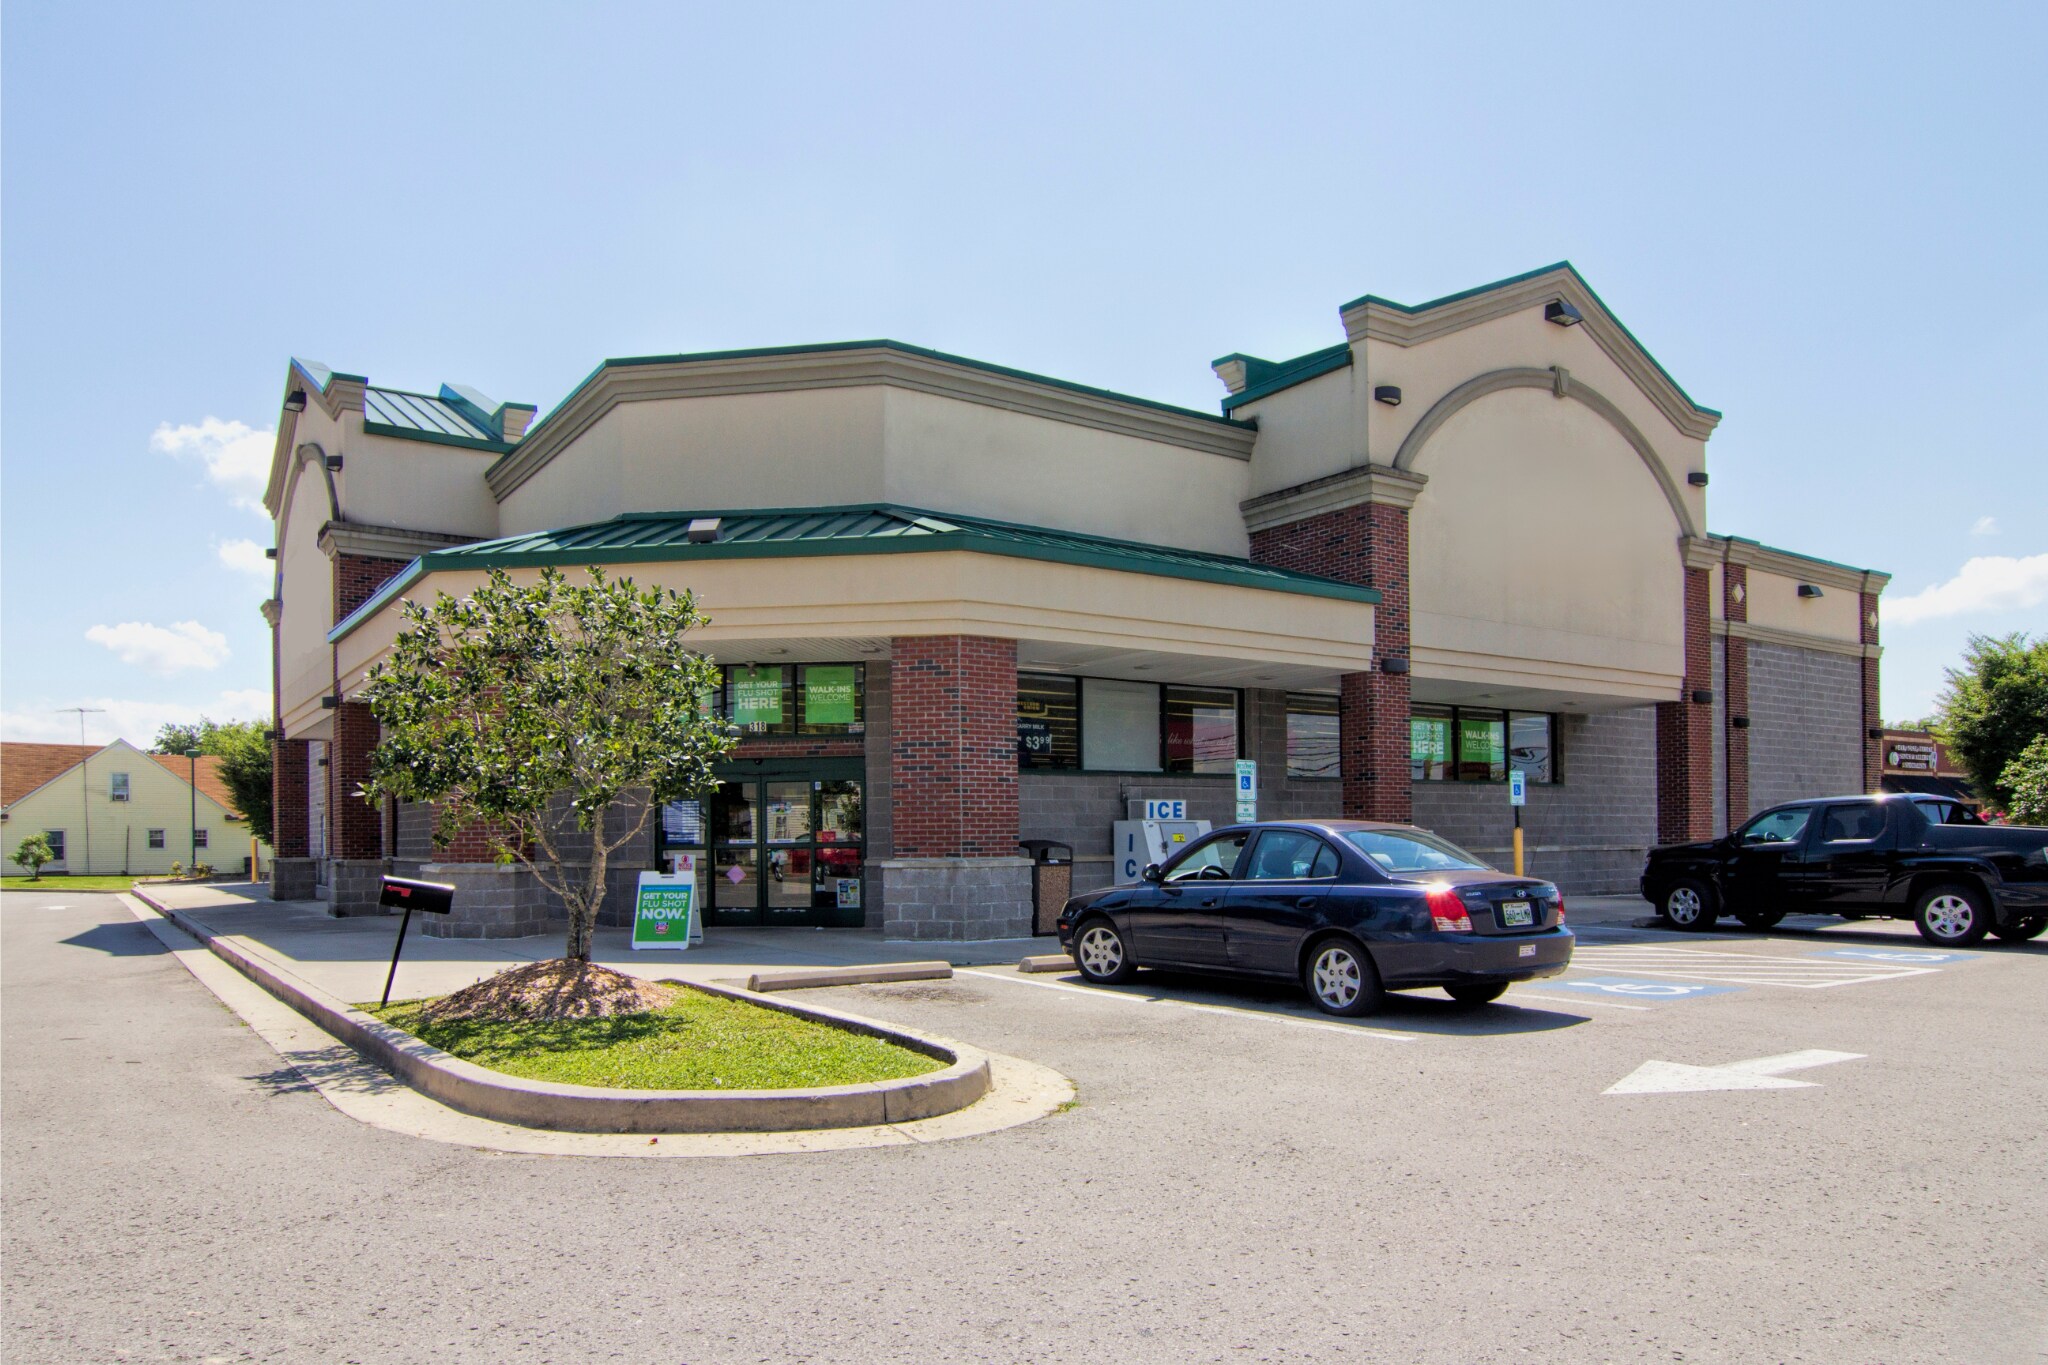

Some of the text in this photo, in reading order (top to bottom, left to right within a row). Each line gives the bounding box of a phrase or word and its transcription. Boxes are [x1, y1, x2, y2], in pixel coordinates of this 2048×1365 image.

[738, 680, 778, 689] GET YOUR
[738, 688, 778, 697] FLU SHOT
[809, 685, 851, 694] WALK-INS
[809, 693, 851, 702] WELCOME
[738, 697, 779, 710] HERE
[749, 721, 767, 732] 318
[1412, 722, 1444, 731] GET YOUR
[1413, 740, 1444, 754] HERE
[1465, 740, 1500, 750] WELCO
[1149, 801, 1183, 818] ICE
[1125, 833, 1137, 878] IC
[643, 892, 688, 900] GET YOUR
[642, 900, 687, 908] FLU SHOT
[641, 908, 686, 920] NOW.
